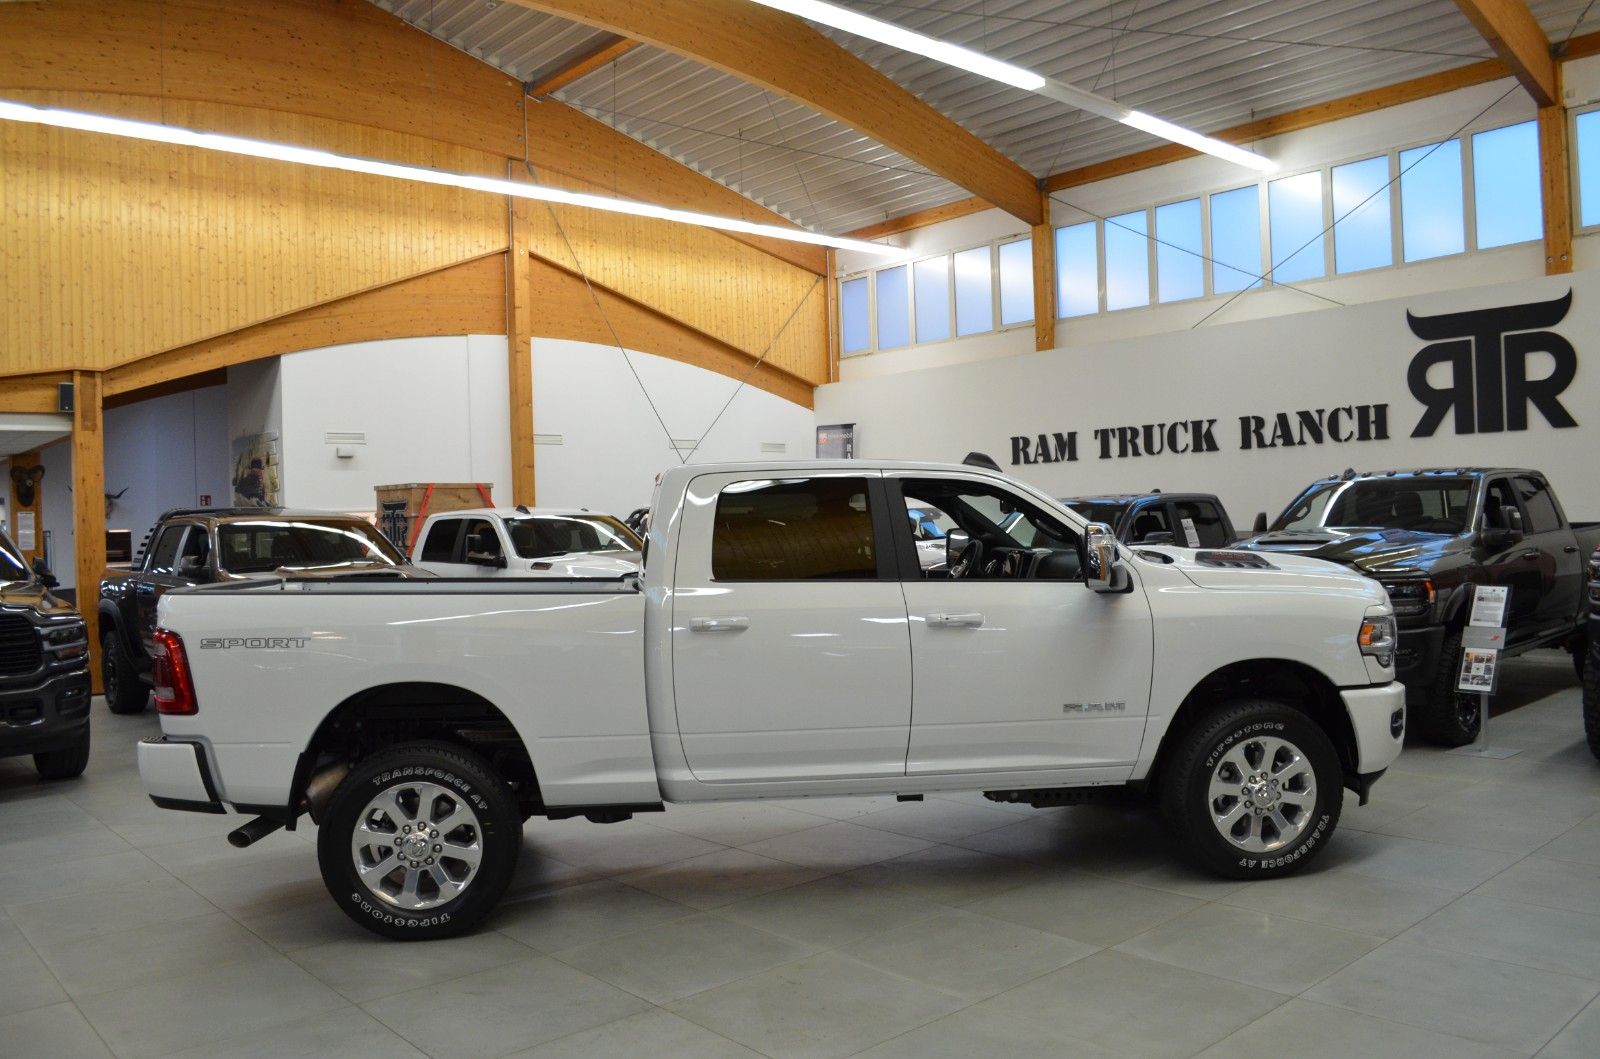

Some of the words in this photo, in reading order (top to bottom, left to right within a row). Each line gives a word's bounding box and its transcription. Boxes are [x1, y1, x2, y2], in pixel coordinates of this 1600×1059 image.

[1407, 287, 1579, 438] RTR
[1010, 432, 1079, 466] RAM
[1093, 418, 1220, 460] TRUCK
[1239, 403, 1390, 450] RANCH
[200, 637, 311, 650] SPORT
[1206, 721, 1286, 768] FIRESTONE
[373, 766, 473, 794] TRANSFORCE
[470, 793, 488, 810] AT
[1238, 857, 1257, 868] AT
[1261, 813, 1330, 869] TRANSFORCE
[351, 892, 451, 928] FIRESTONE
